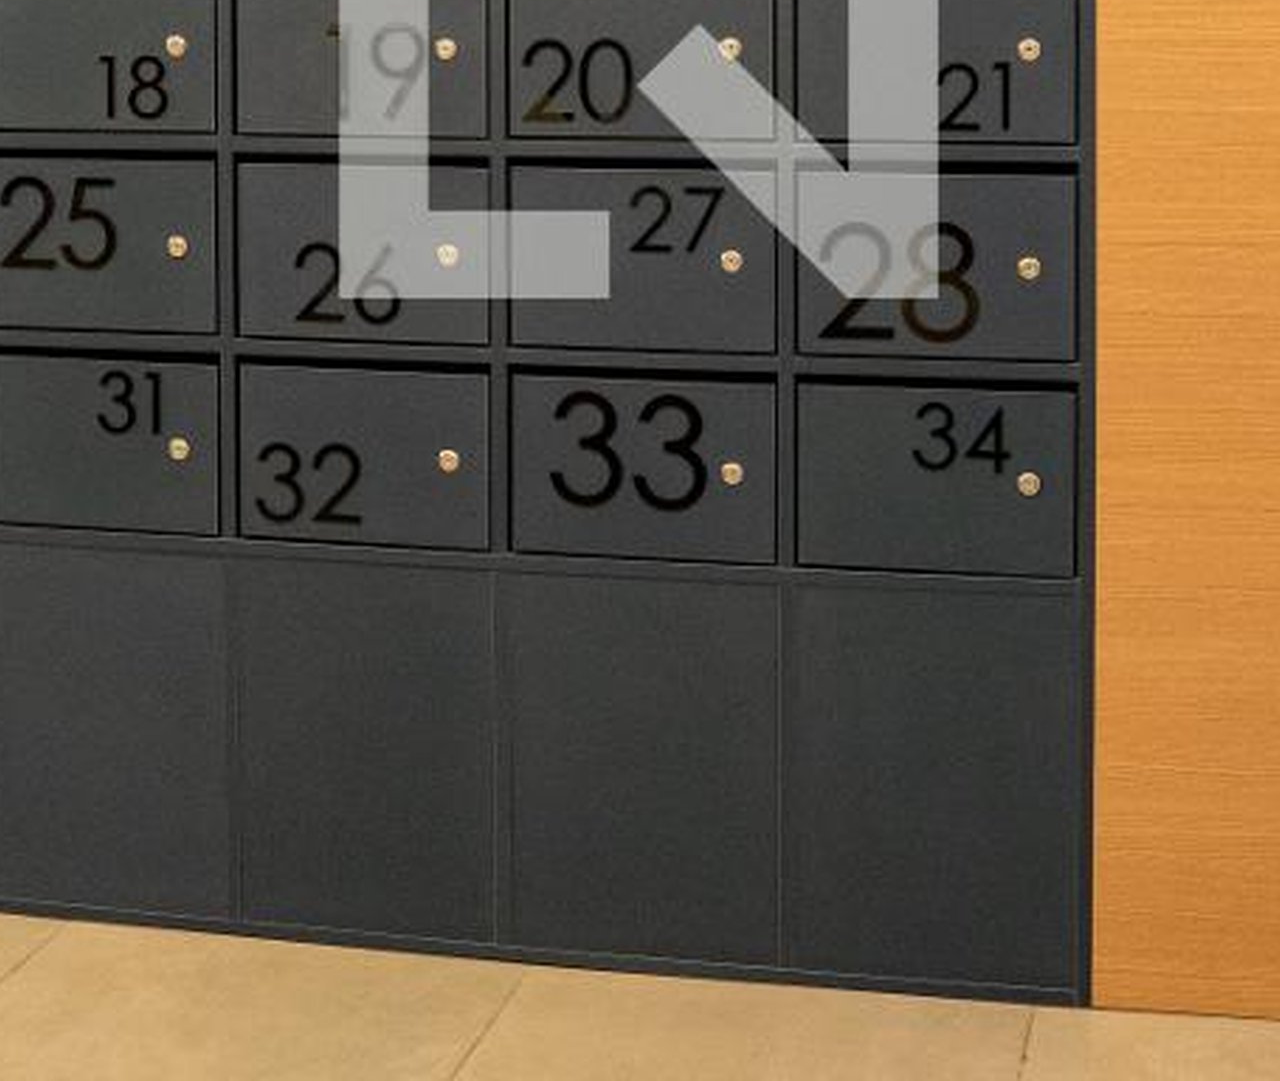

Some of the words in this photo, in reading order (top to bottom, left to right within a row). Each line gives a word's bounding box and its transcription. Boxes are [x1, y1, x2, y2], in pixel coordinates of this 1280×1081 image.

[99, 55, 168, 120] 18
[326, 23, 424, 121] 19
[521, 38, 633, 123] 20
[937, 62, 1013, 132] 21
[0, 176, 117, 271] 25
[628, 186, 725, 253] 27
[294, 243, 401, 327] 26
[817, 221, 981, 344] 28
[97, 370, 161, 436] 31
[912, 401, 1011, 474] 34
[255, 442, 363, 526] 32
[549, 390, 708, 511] 33
